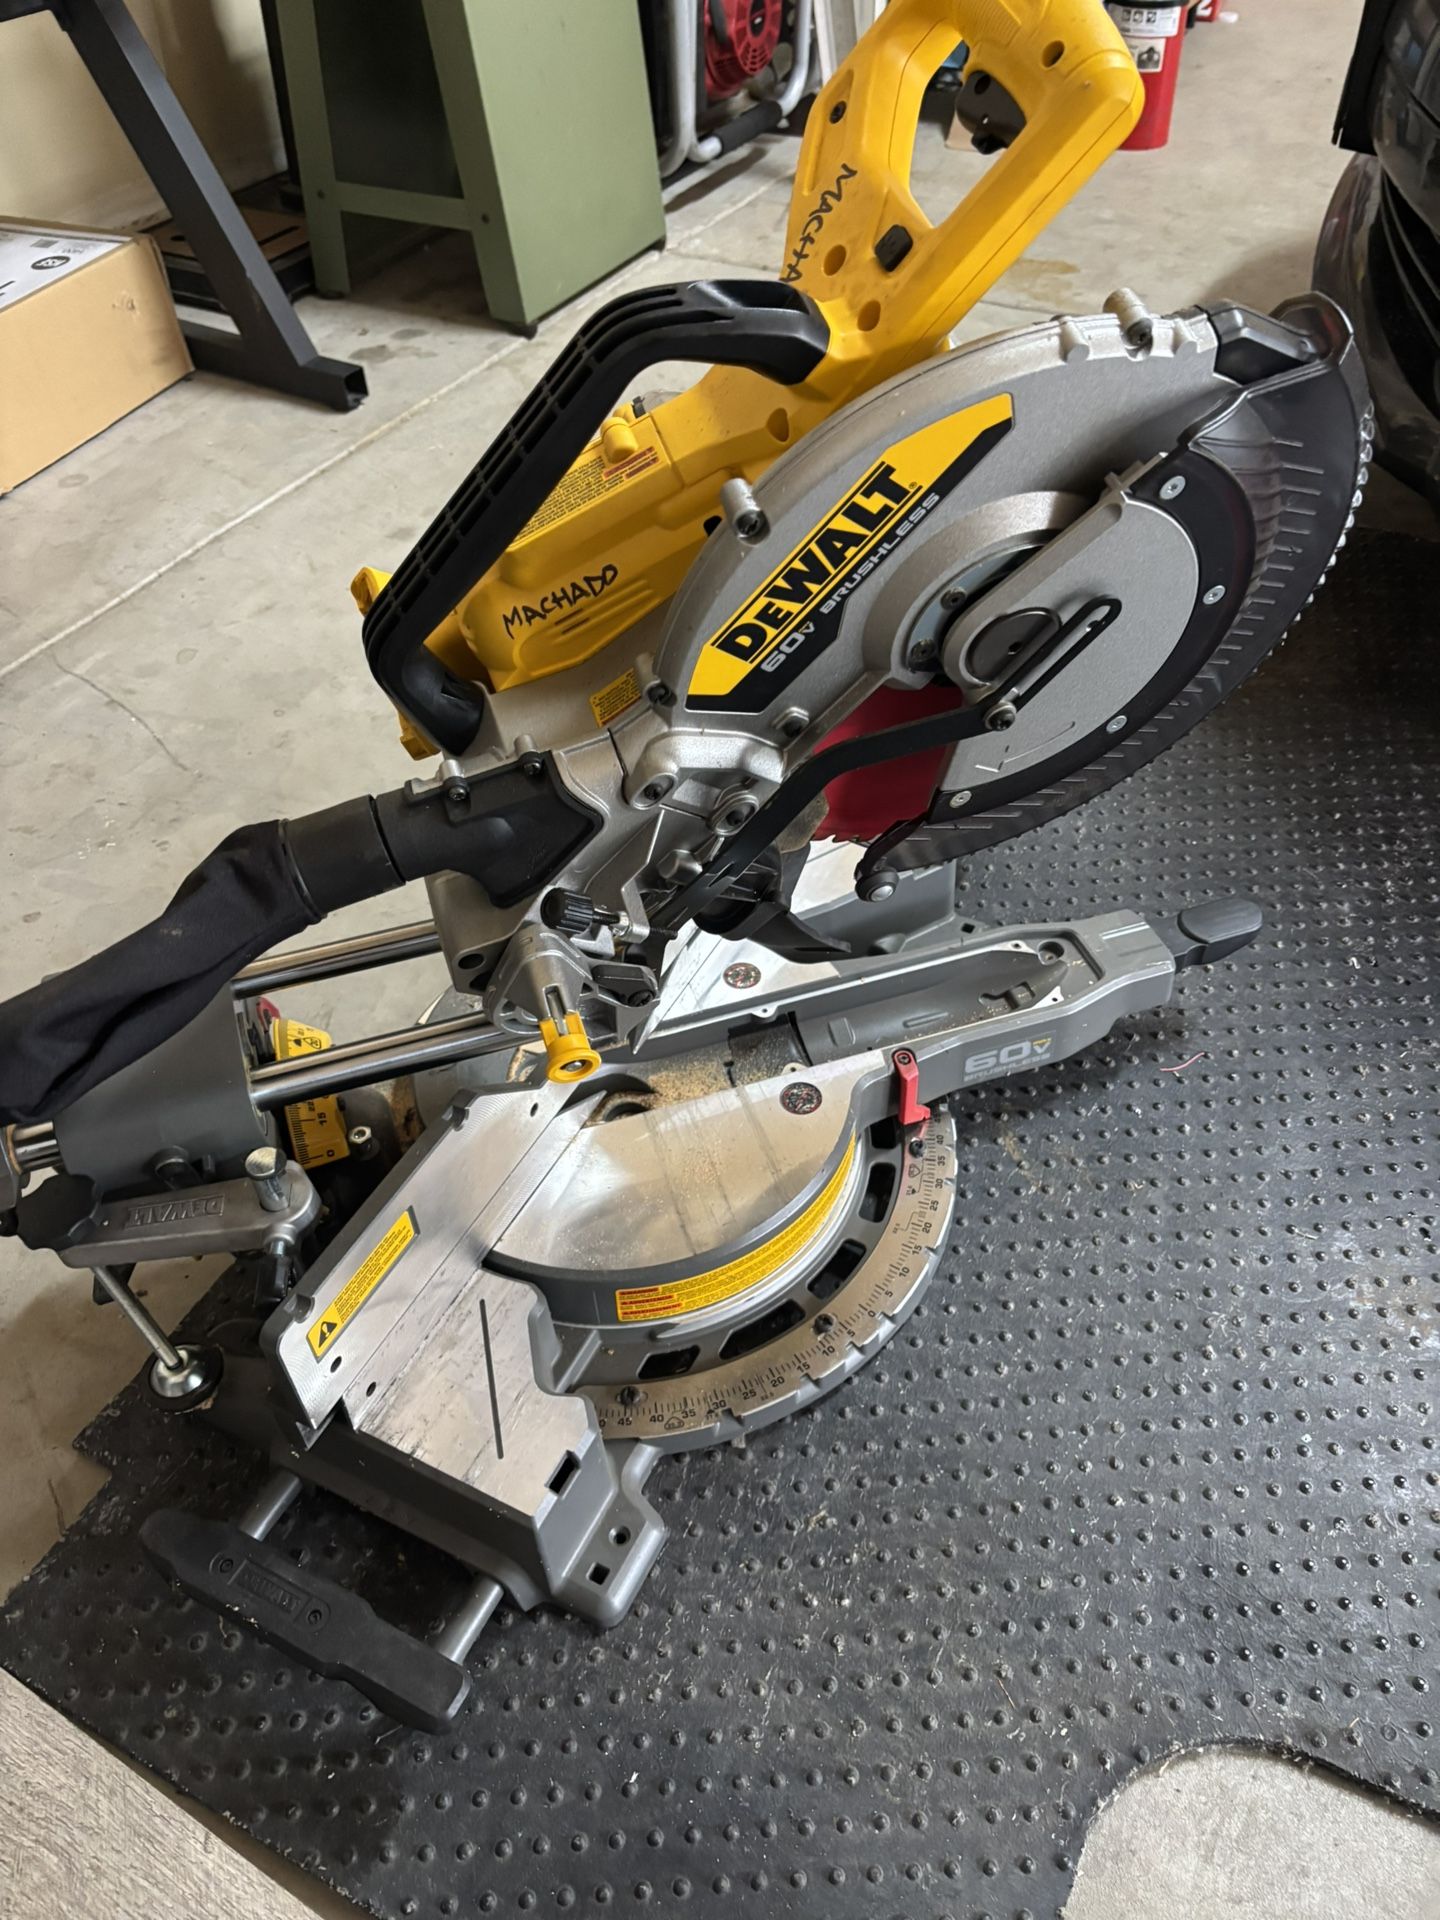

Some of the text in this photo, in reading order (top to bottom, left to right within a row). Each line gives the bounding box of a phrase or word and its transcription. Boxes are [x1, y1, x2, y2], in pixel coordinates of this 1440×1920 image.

[715, 464, 911, 662] DEWALT
[760, 492, 939, 673] 60V BRUSHLESS
[502, 564, 618, 640] MACHADO
[317, 1112, 327, 1127] 15
[936, 1135, 944, 1145] 40
[938, 1156, 946, 1166] 35
[935, 1179, 943, 1189] 30
[929, 1200, 939, 1211] 25
[921, 1222, 932, 1234] 20
[911, 1245, 922, 1255] 15
[899, 1267, 910, 1278] 10
[847, 1330, 855, 1338] 5
[822, 1346, 835, 1357] 10
[797, 1362, 810, 1373] 15
[770, 1376, 785, 1388] 20
[742, 1390, 757, 1400] 25
[712, 1400, 727, 1410] 30
[649, 1414, 664, 1423] 40
[681, 1408, 697, 1419] 35
[617, 1417, 632, 1426] 45
